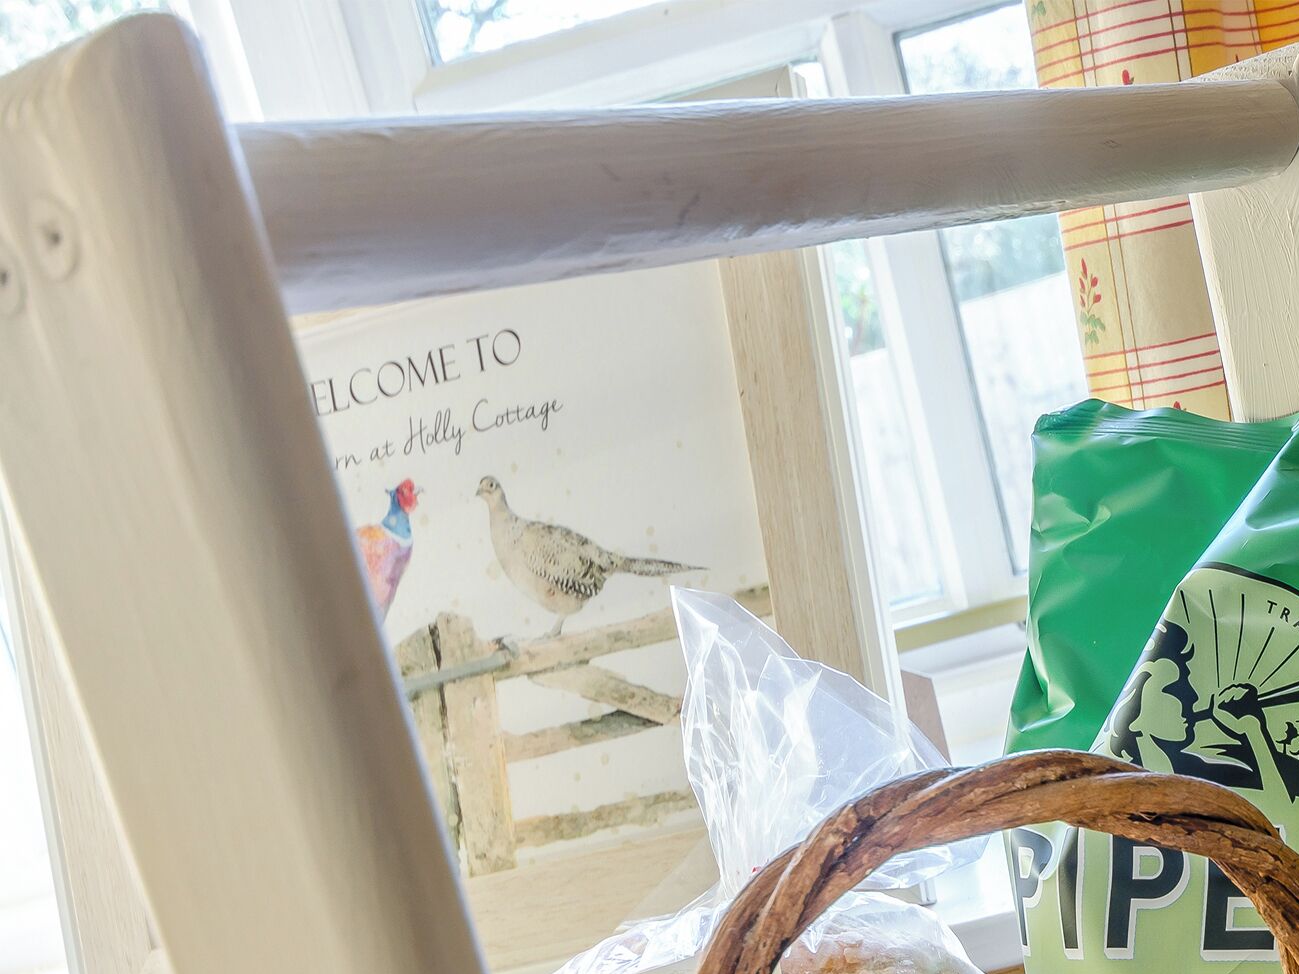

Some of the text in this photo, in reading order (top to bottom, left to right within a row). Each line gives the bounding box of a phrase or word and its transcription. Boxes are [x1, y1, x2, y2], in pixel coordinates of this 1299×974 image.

[310, 328, 521, 417] ELCOME TO
[370, 441, 394, 461] at
[404, 408, 465, 456] Holly
[472, 398, 563, 431] Cottage
